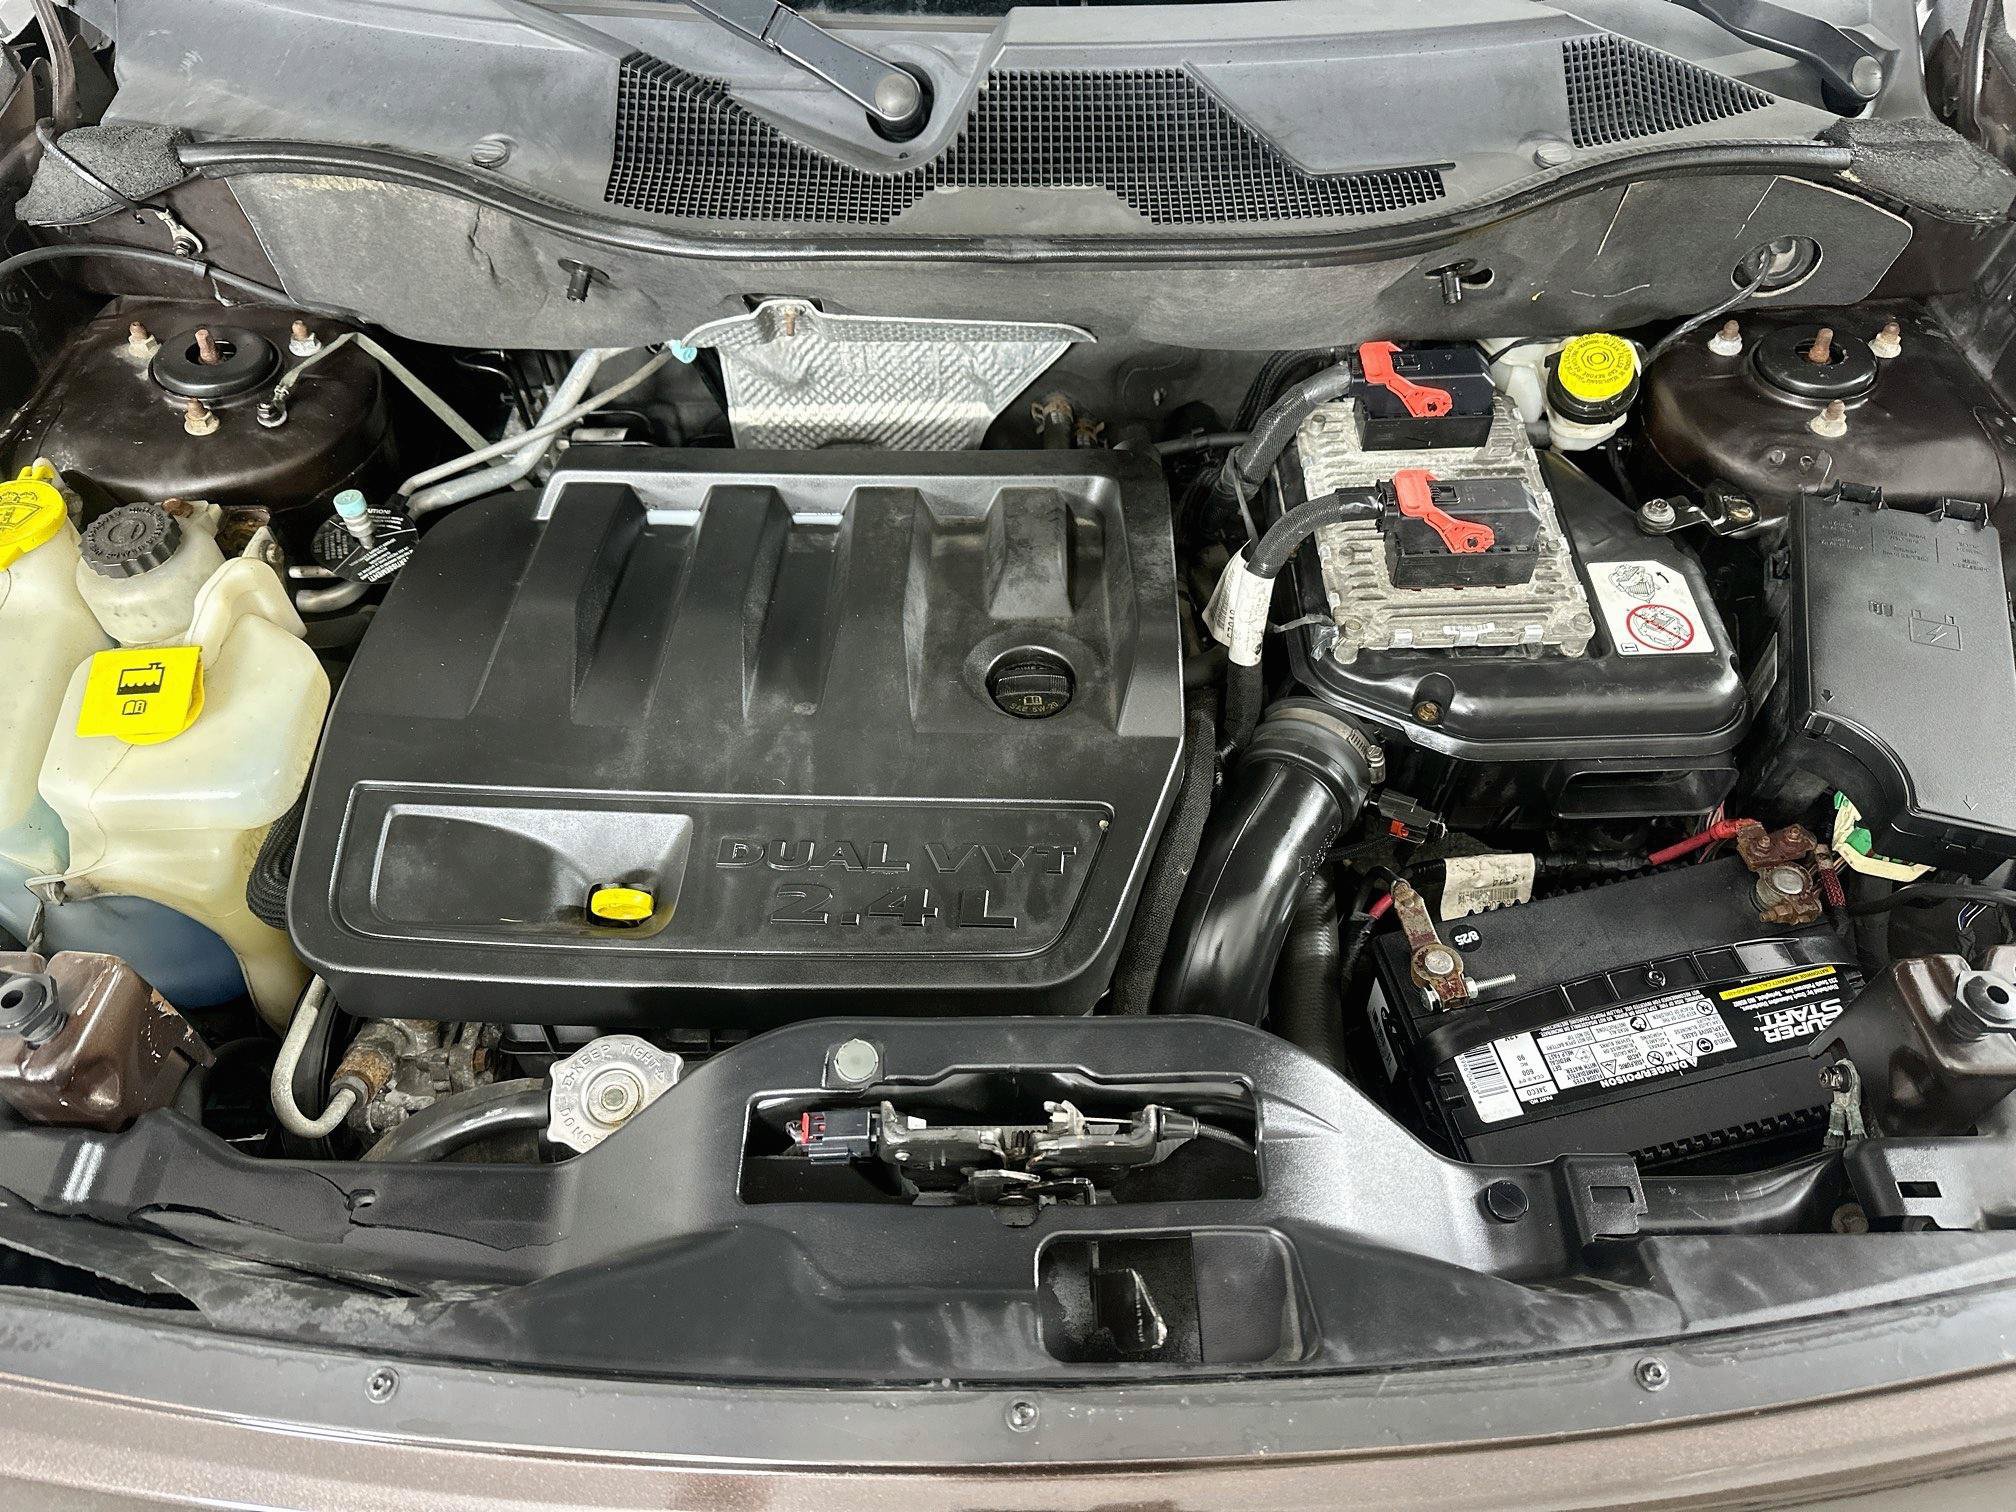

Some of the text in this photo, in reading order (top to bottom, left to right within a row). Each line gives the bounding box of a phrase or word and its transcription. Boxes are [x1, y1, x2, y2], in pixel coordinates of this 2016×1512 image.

[716, 835, 1078, 875] DUAL VVT
[1454, 930, 1480, 946] 8/25
[1760, 998, 1843, 1031] START
[1764, 1017, 1835, 1043] SUPER
[570, 1042, 662, 1074] KEEP TIGHT
[1600, 1060, 1687, 1087] DANGER/POISON
